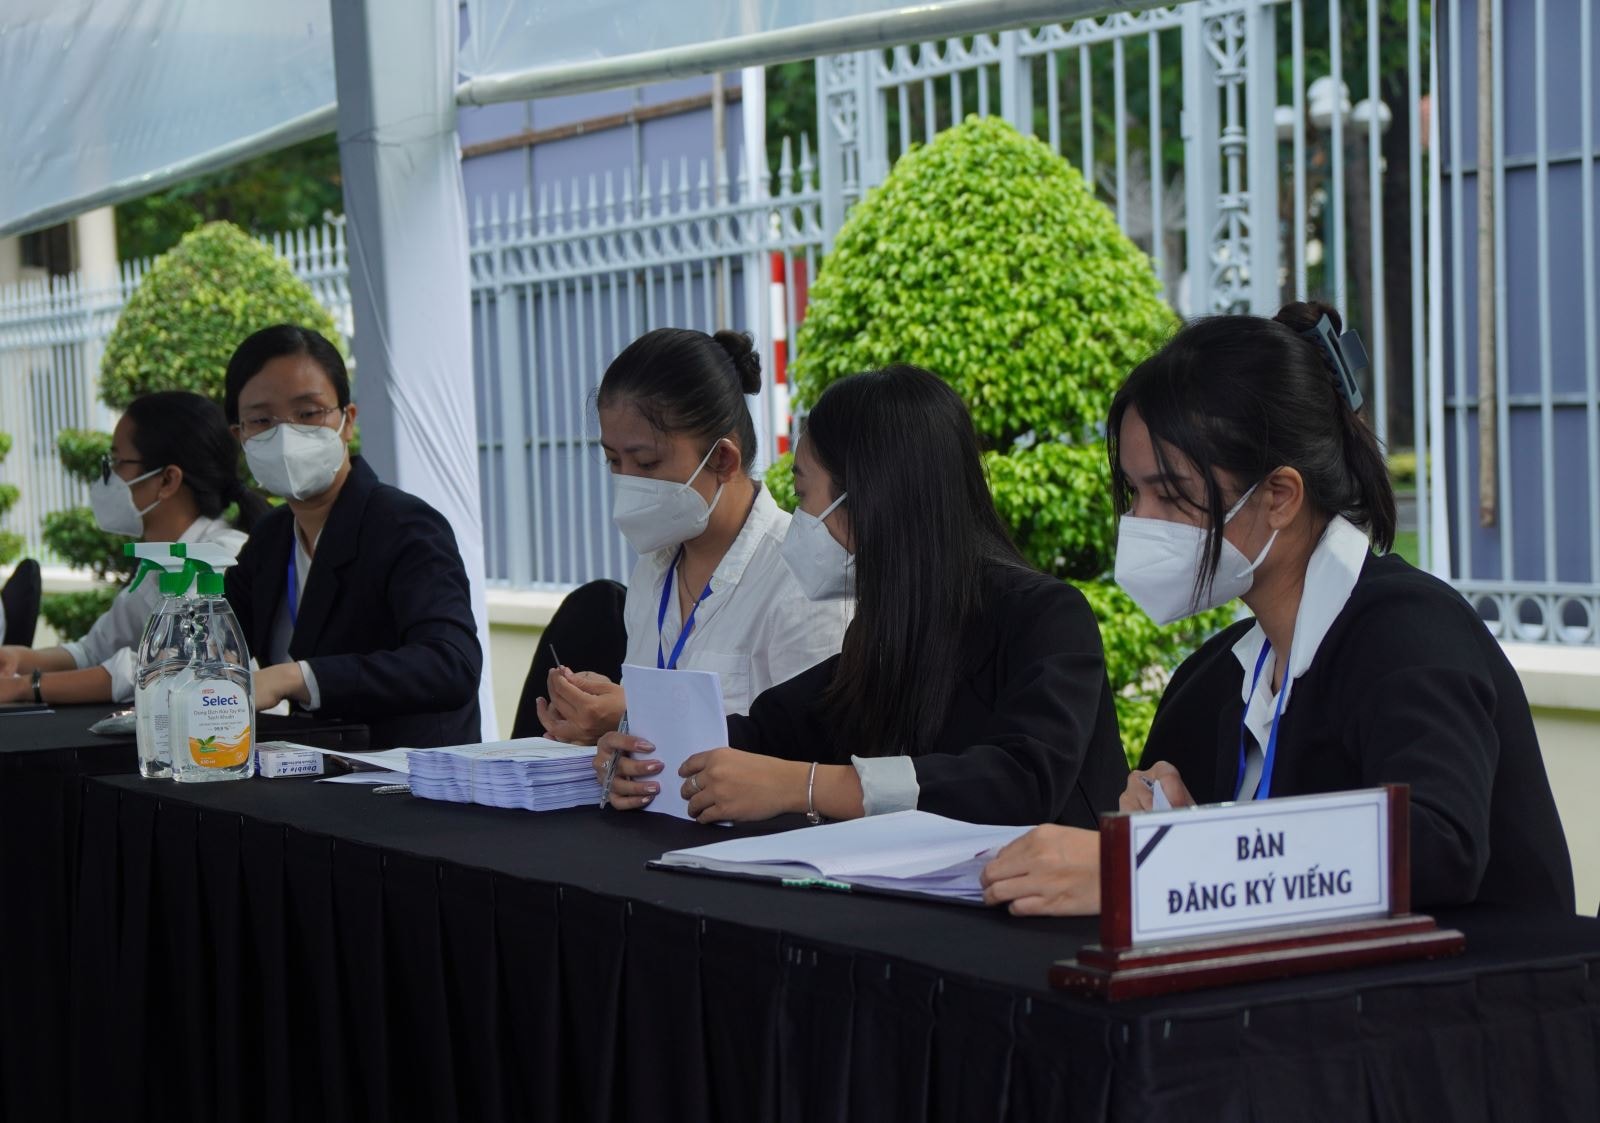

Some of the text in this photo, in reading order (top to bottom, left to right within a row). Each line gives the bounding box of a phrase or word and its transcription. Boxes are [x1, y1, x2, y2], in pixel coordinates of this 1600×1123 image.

[202, 695, 238, 706] Select
[290, 765, 317, 773] Double
[1236, 828, 1285, 862] BÀN
[1167, 864, 1353, 915] ĐĂNG KÝ VIẾNG
